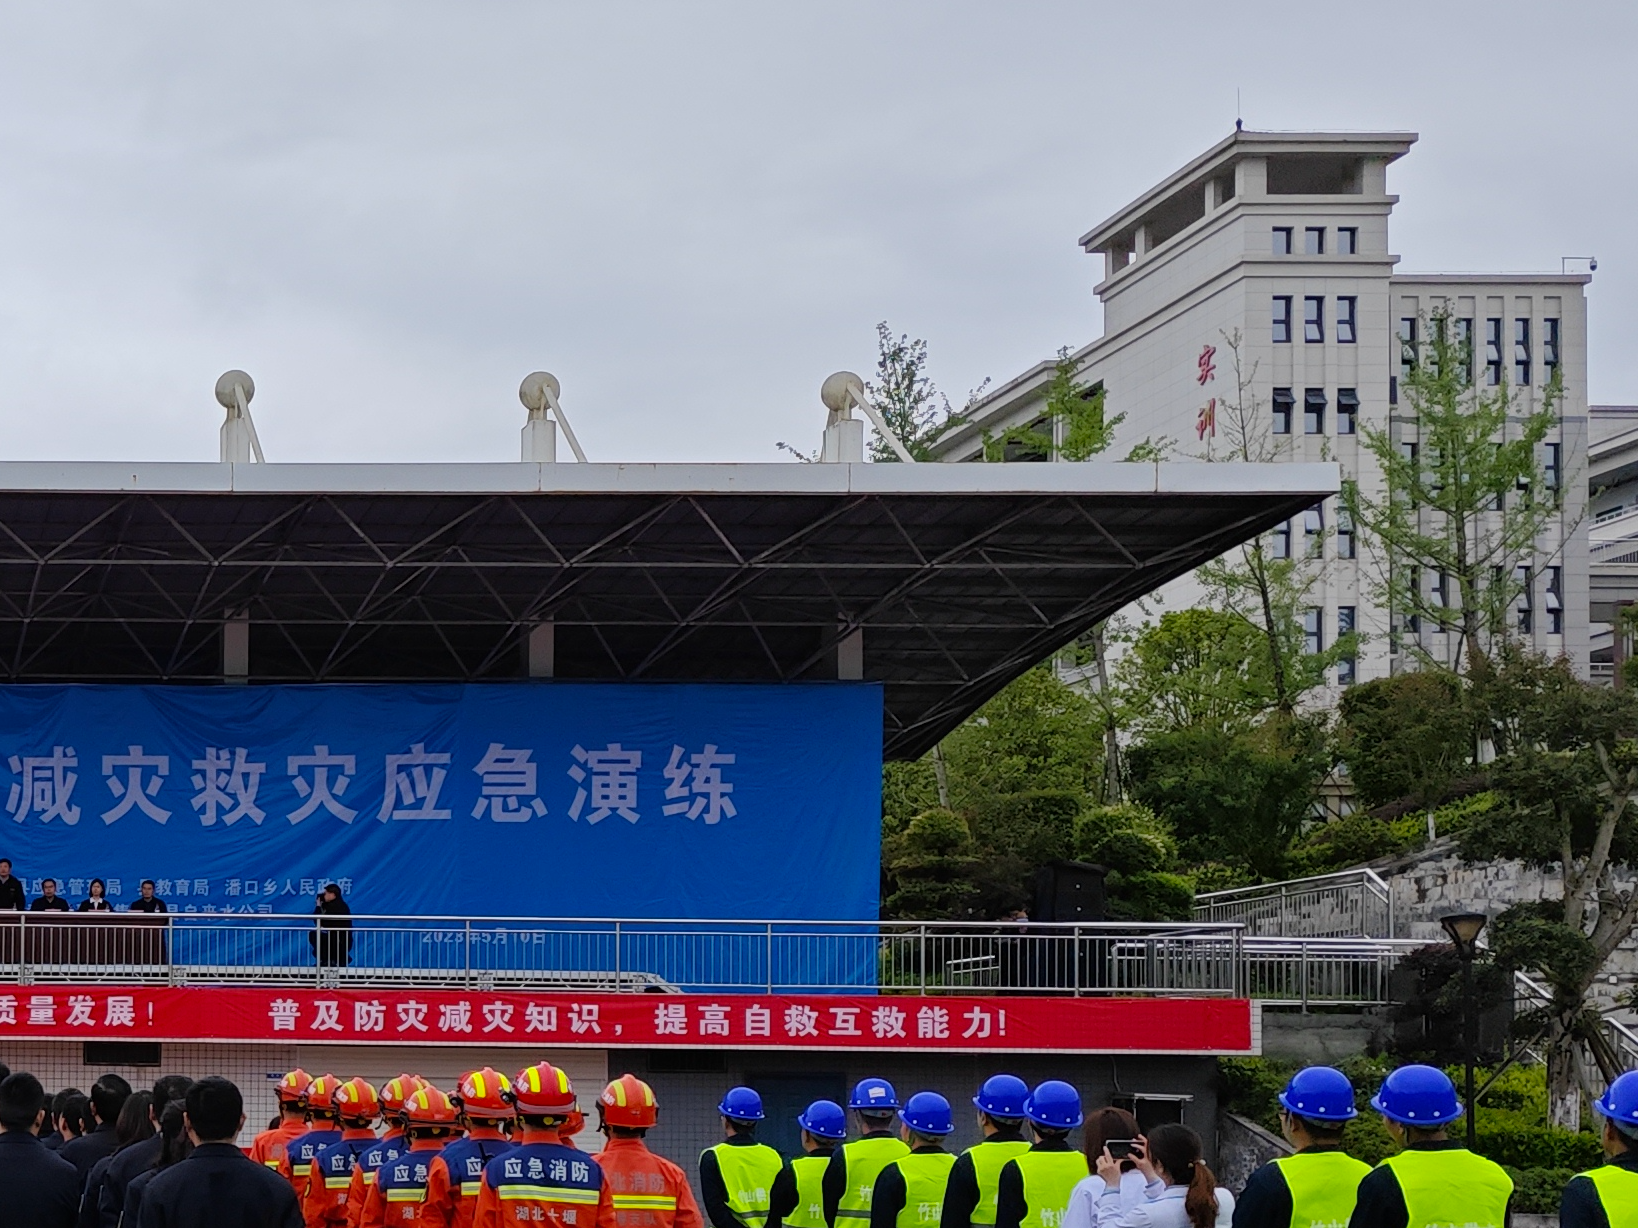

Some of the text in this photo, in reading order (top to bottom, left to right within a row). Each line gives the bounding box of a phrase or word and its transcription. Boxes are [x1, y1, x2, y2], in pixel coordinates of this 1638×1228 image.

[504, 1157, 590, 1183] 应急消防
[515, 1205, 577, 1226] 湖北十堰
